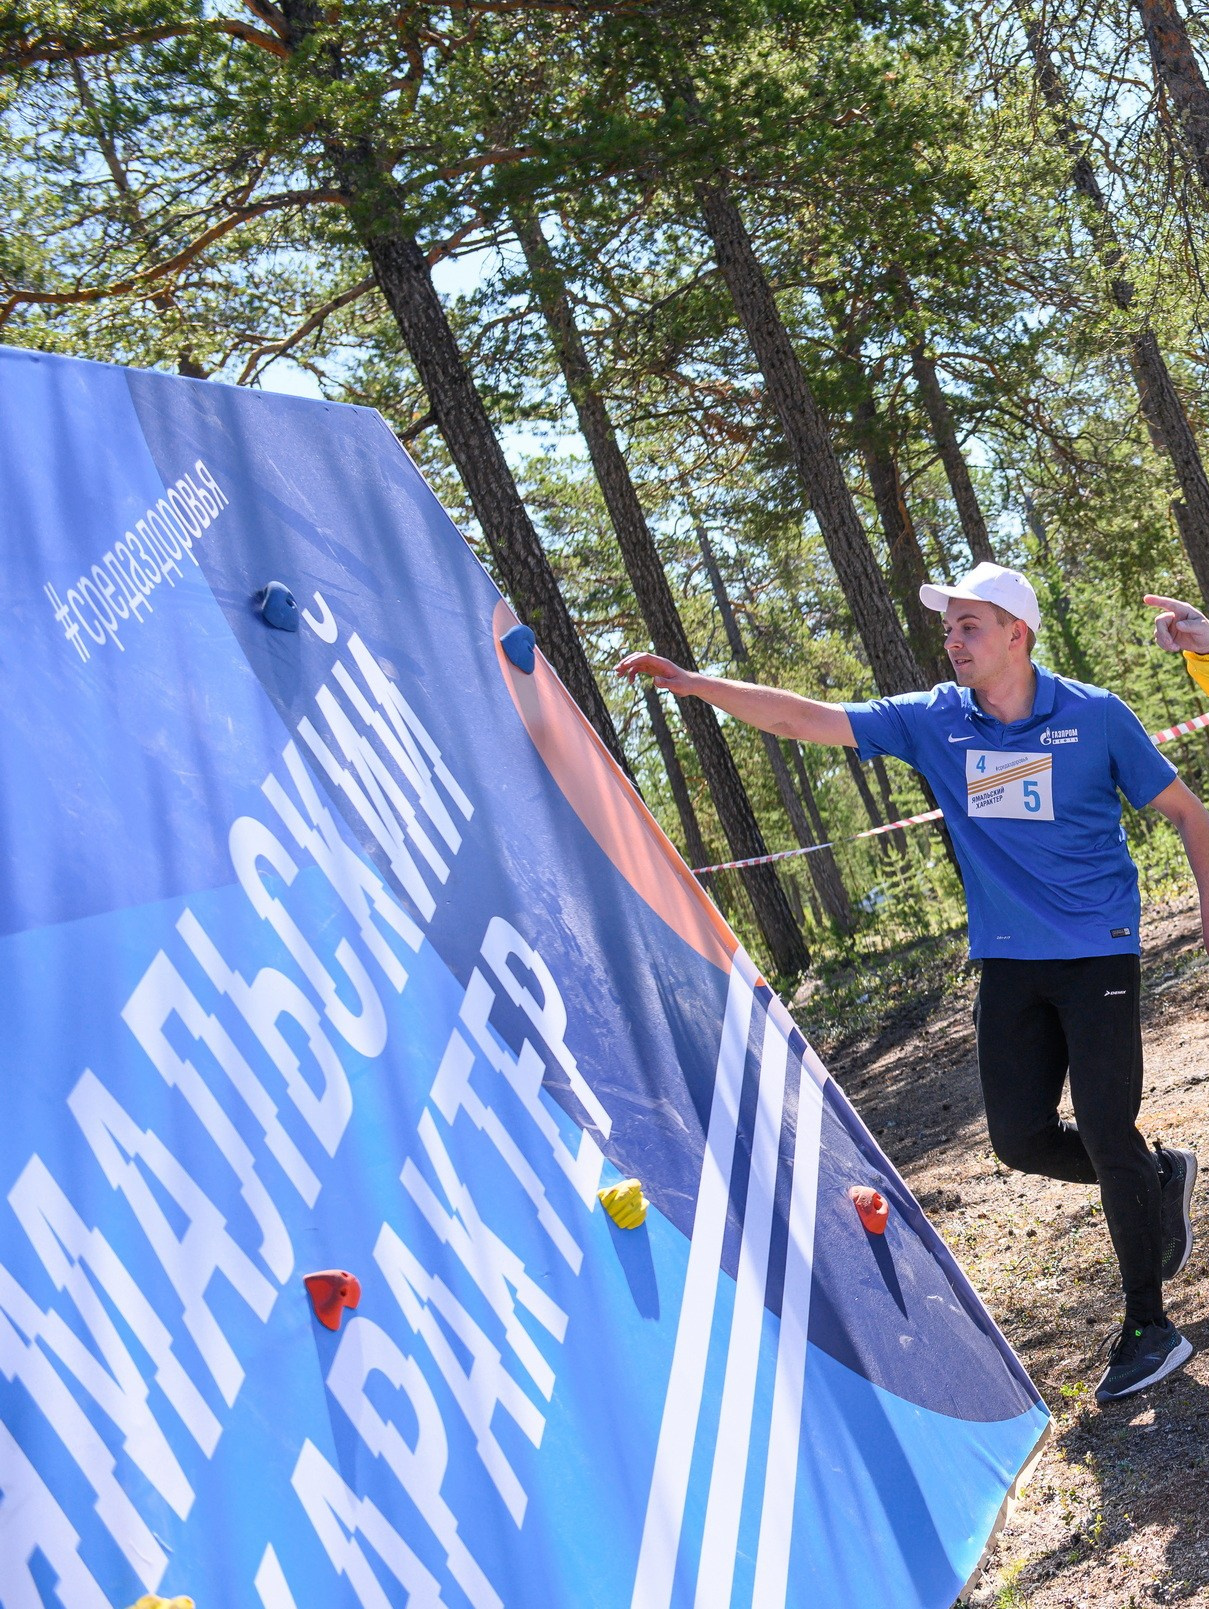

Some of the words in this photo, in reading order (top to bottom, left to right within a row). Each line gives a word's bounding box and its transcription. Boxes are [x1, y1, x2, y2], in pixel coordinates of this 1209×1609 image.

[43, 459, 230, 663] #средаздоровья
[976, 755, 986, 773] 4
[1023, 781, 1041, 813] 5
